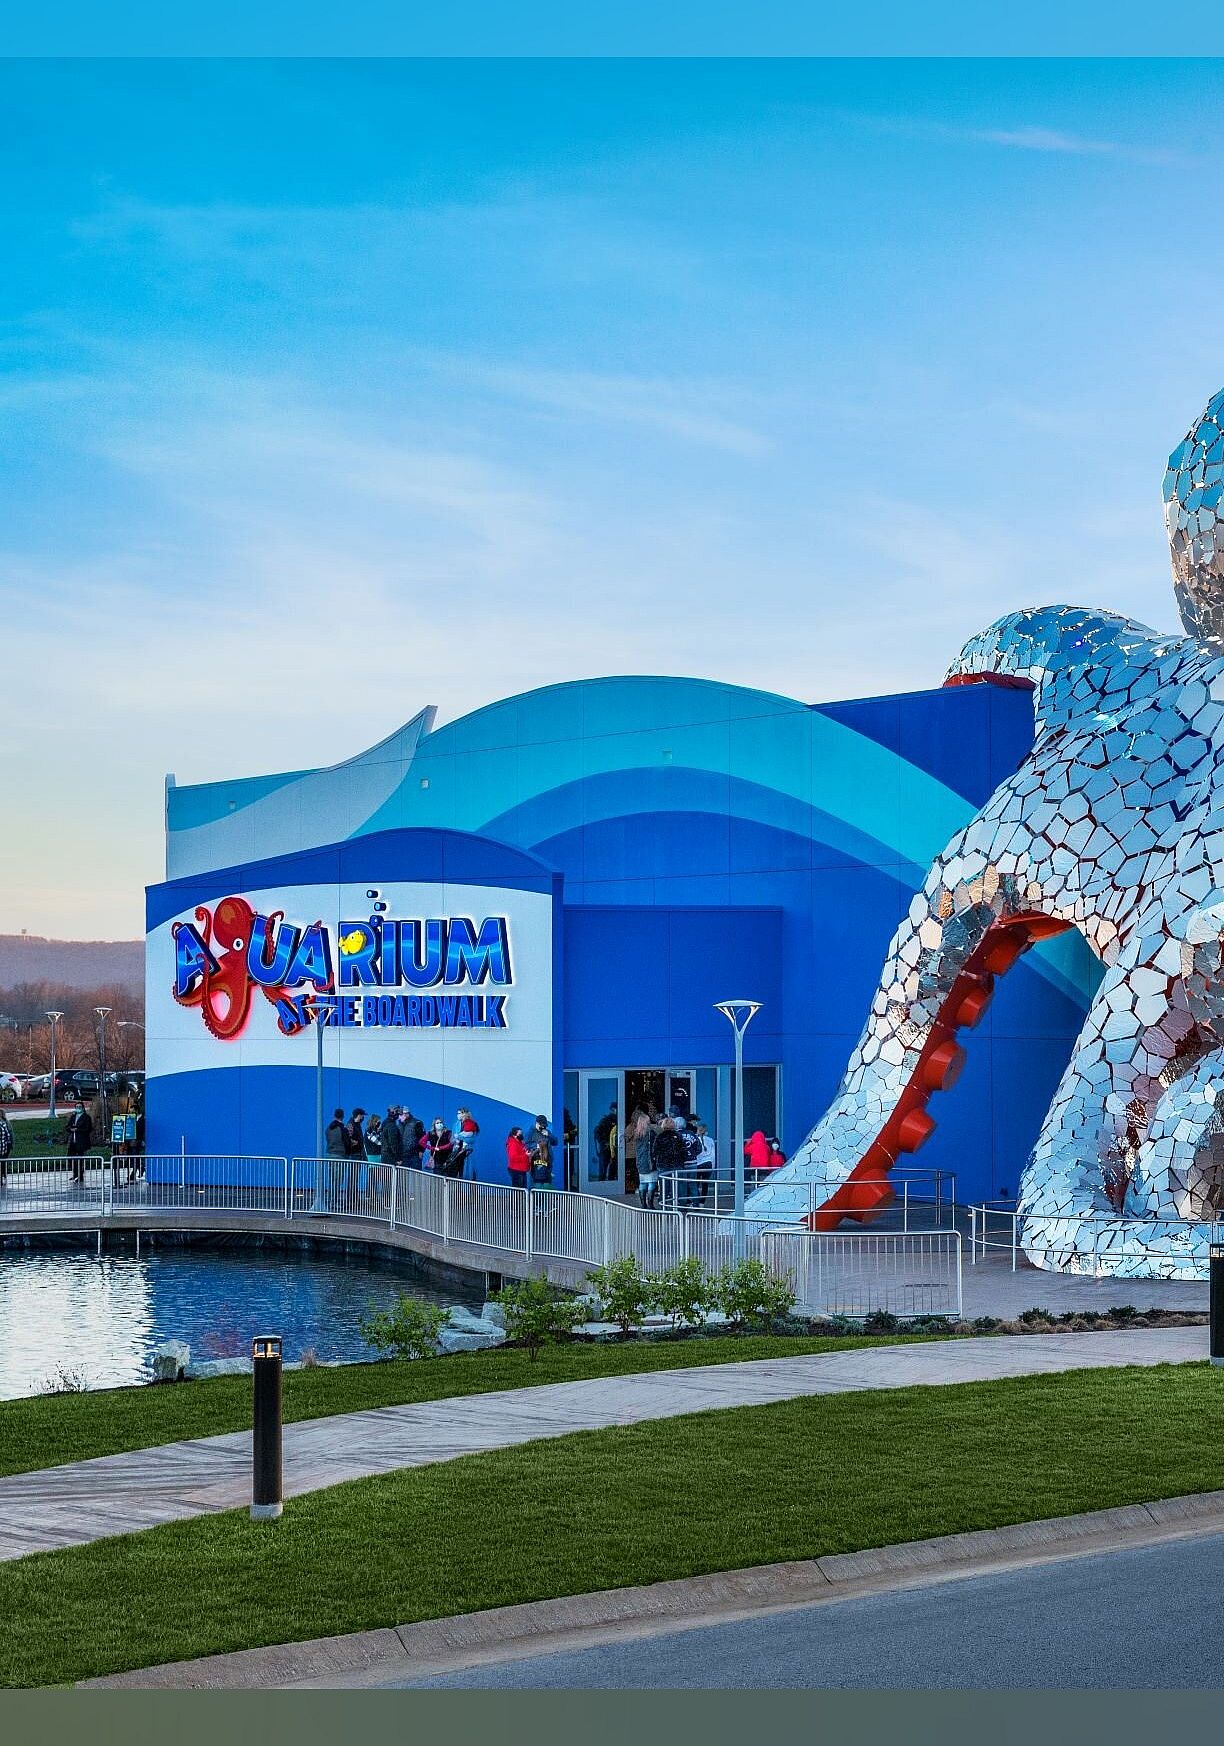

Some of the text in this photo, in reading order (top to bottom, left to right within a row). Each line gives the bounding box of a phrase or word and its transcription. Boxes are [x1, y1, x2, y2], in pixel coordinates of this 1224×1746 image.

[172, 897, 513, 1039] AQUARIUM
[274, 993, 507, 1031] AT THE BOARDWALK
